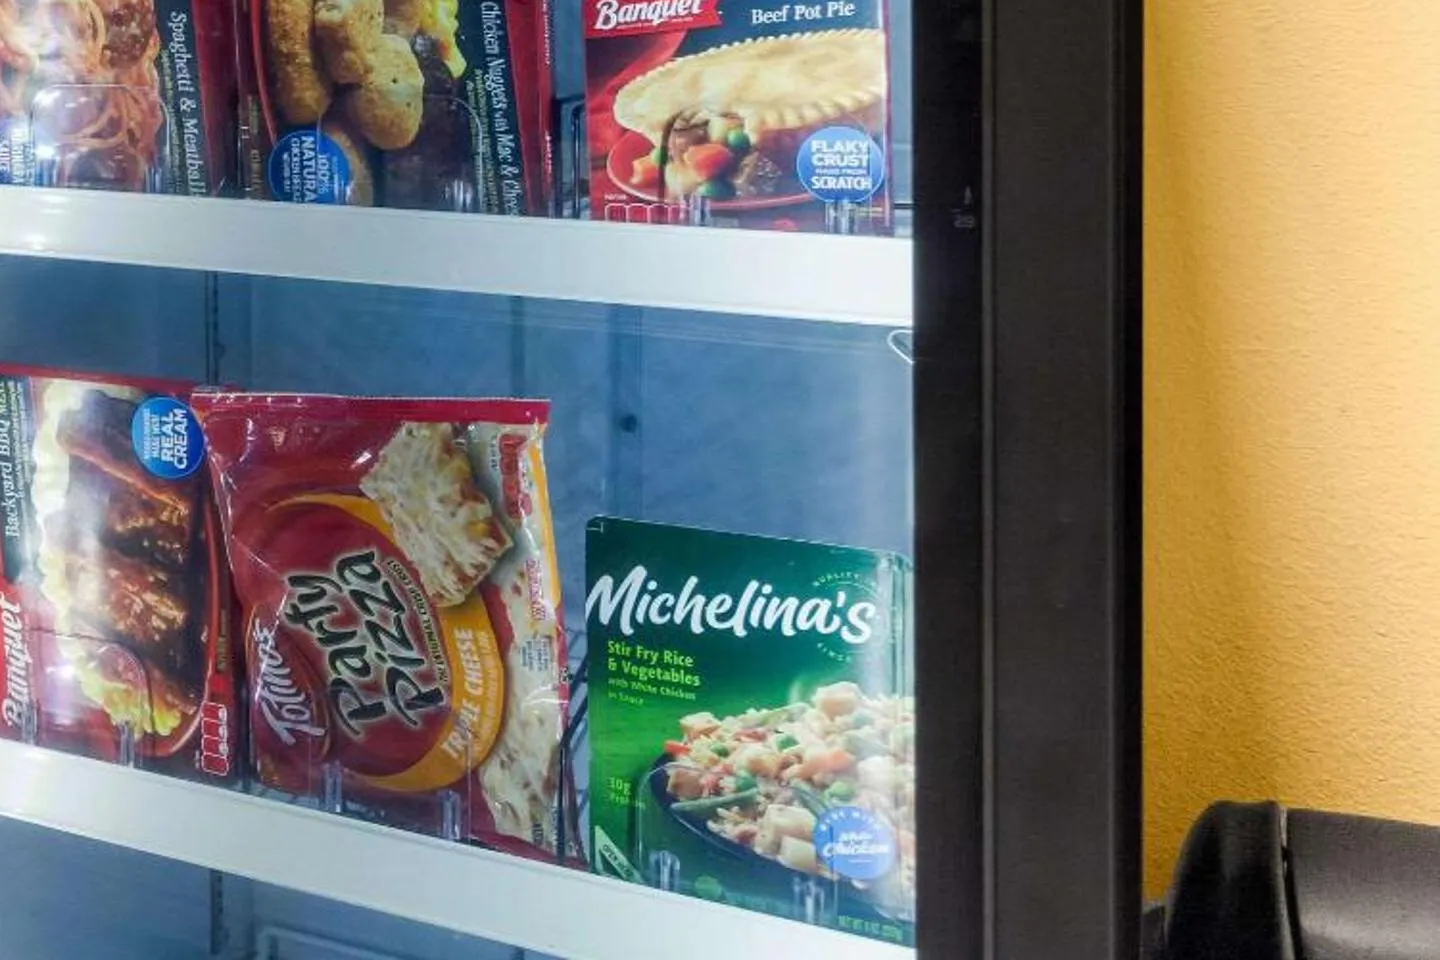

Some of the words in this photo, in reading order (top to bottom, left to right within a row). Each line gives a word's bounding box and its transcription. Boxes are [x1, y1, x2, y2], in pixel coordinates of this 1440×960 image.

[480, 0, 502, 56] Chicken
[751, 4, 790, 25] Beef
[793, 3, 822, 21] Pot
[827, 0, 856, 18] Pie
[168, 10, 195, 92] Spaghetti
[179, 97, 197, 112] &
[483, 56, 508, 111] Nuggets
[182, 117, 207, 195] Meatball
[300, 135, 317, 202] NATURA
[496, 134, 516, 163] Mac
[501, 162, 520, 176] &
[811, 140, 869, 153] FLAKY
[811, 153, 869, 167] CRUST
[317, 153, 331, 195] 100%
[811, 176, 873, 190] SCRATCH
[161, 411, 174, 462] REAL
[173, 408, 188, 470] CREAM
[585, 565, 876, 645] Michelina's
[284, 574, 388, 736] Party
[336, 551, 445, 727] Pizza
[455, 628, 484, 696] CHEESE
[607, 640, 632, 657] Stir
[636, 644, 660, 665] Fry
[663, 650, 695, 667] Rice
[607, 657, 617, 671] &
[621, 660, 701, 687] Vegetables
